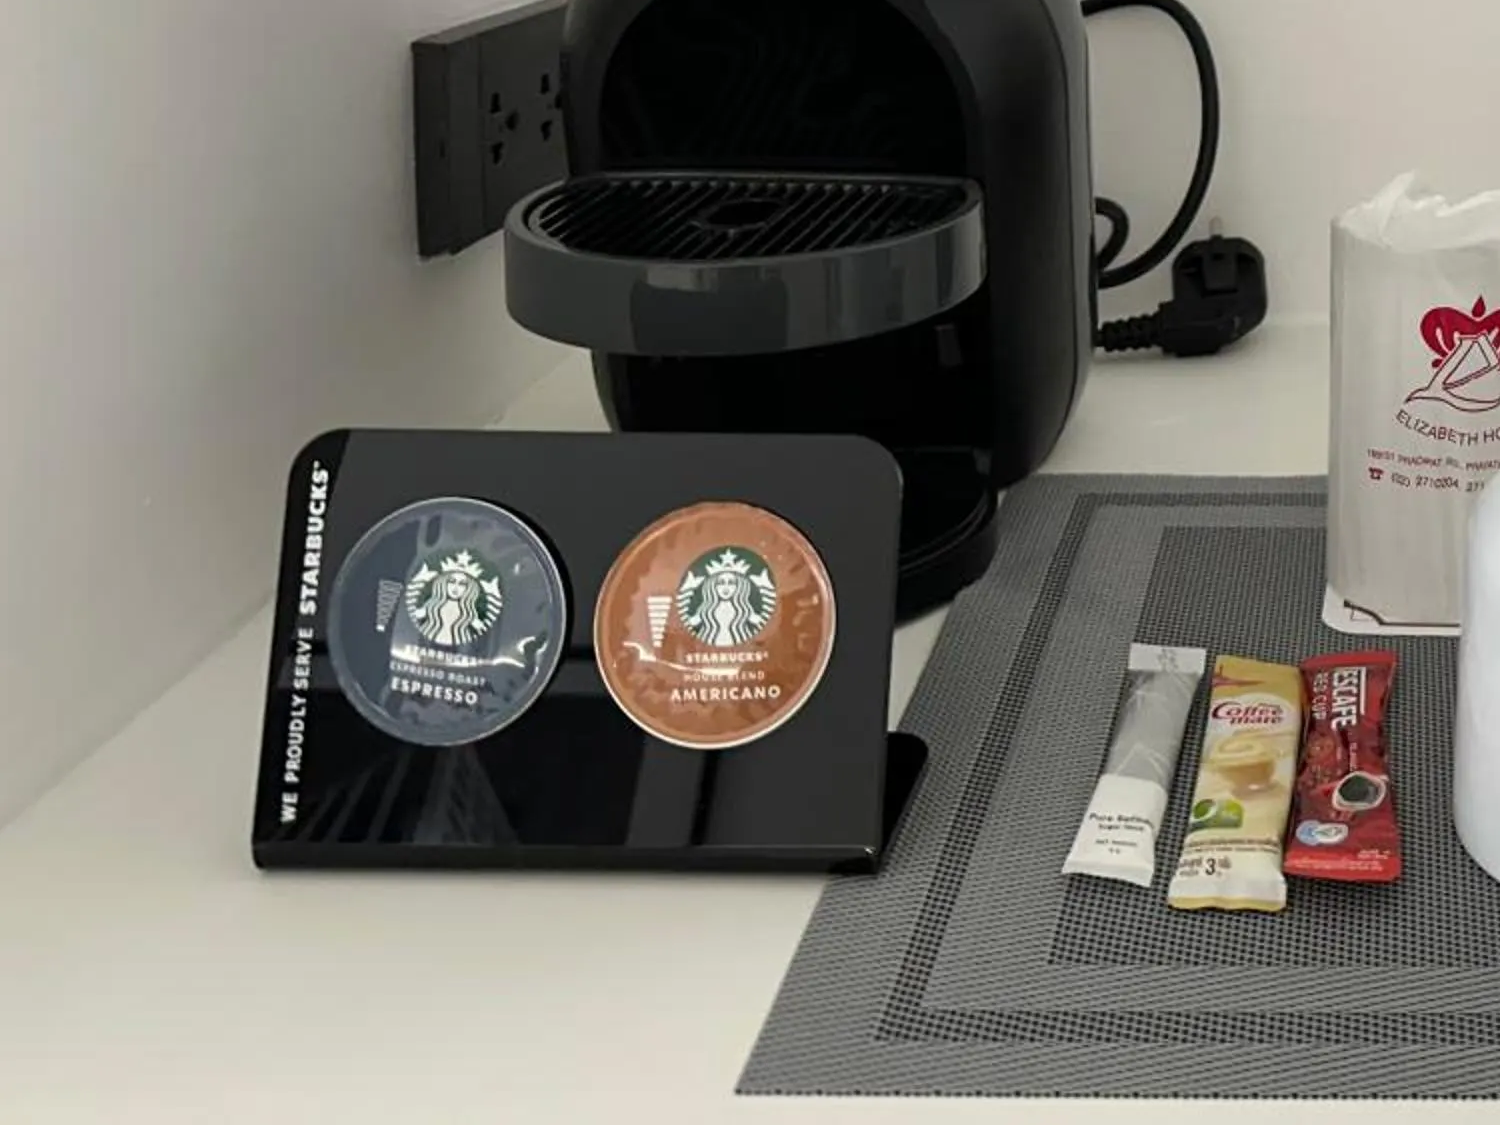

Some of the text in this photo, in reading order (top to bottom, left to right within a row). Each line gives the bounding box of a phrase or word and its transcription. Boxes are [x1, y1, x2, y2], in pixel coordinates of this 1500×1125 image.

[1396, 409, 1479, 446] ELIZABETH
[293, 627, 315, 691] SERVE
[391, 675, 479, 705] ESPRESSO
[671, 684, 781, 702] AMERICANO
[284, 693, 308, 784] PROUDLY
[280, 791, 299, 824] WE
[1205, 858, 1217, 876] 3
